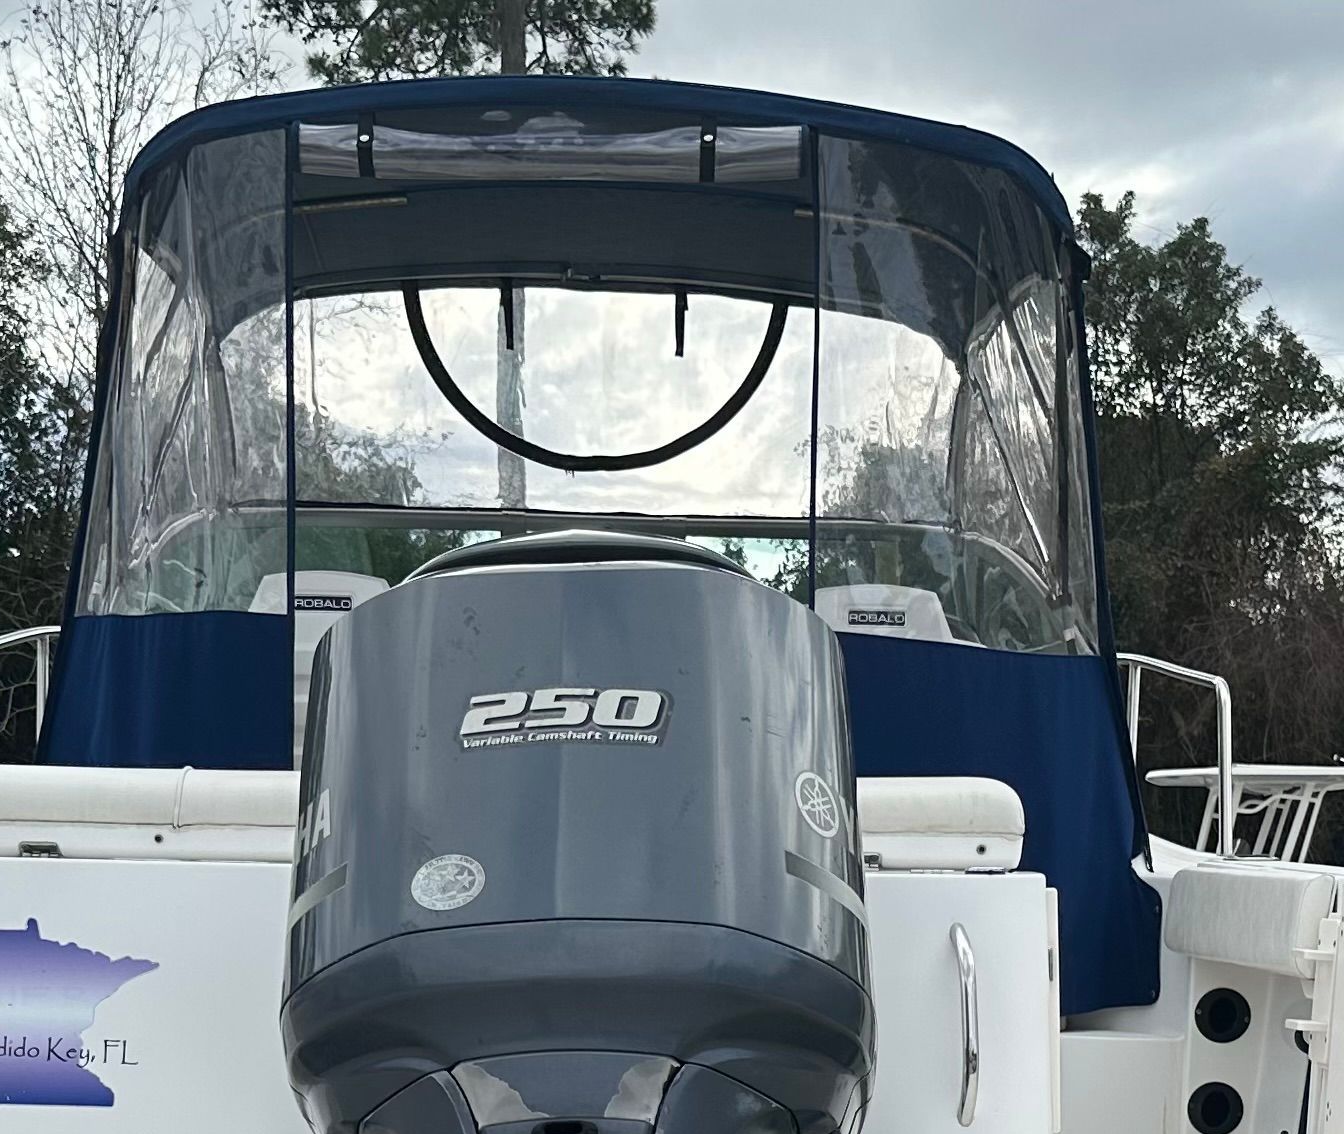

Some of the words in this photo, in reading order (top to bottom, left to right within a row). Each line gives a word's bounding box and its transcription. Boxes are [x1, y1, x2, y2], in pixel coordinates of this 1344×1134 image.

[294, 598, 351, 609] ROBALO
[849, 613, 905, 624] ROBALO
[460, 687, 663, 737] 250
[462, 734, 524, 749] Variable
[527, 730, 603, 743] Camshaft
[607, 731, 658, 744] Timing
[46, 1036, 97, 1068] Key,
[103, 1039, 140, 1066] FL
